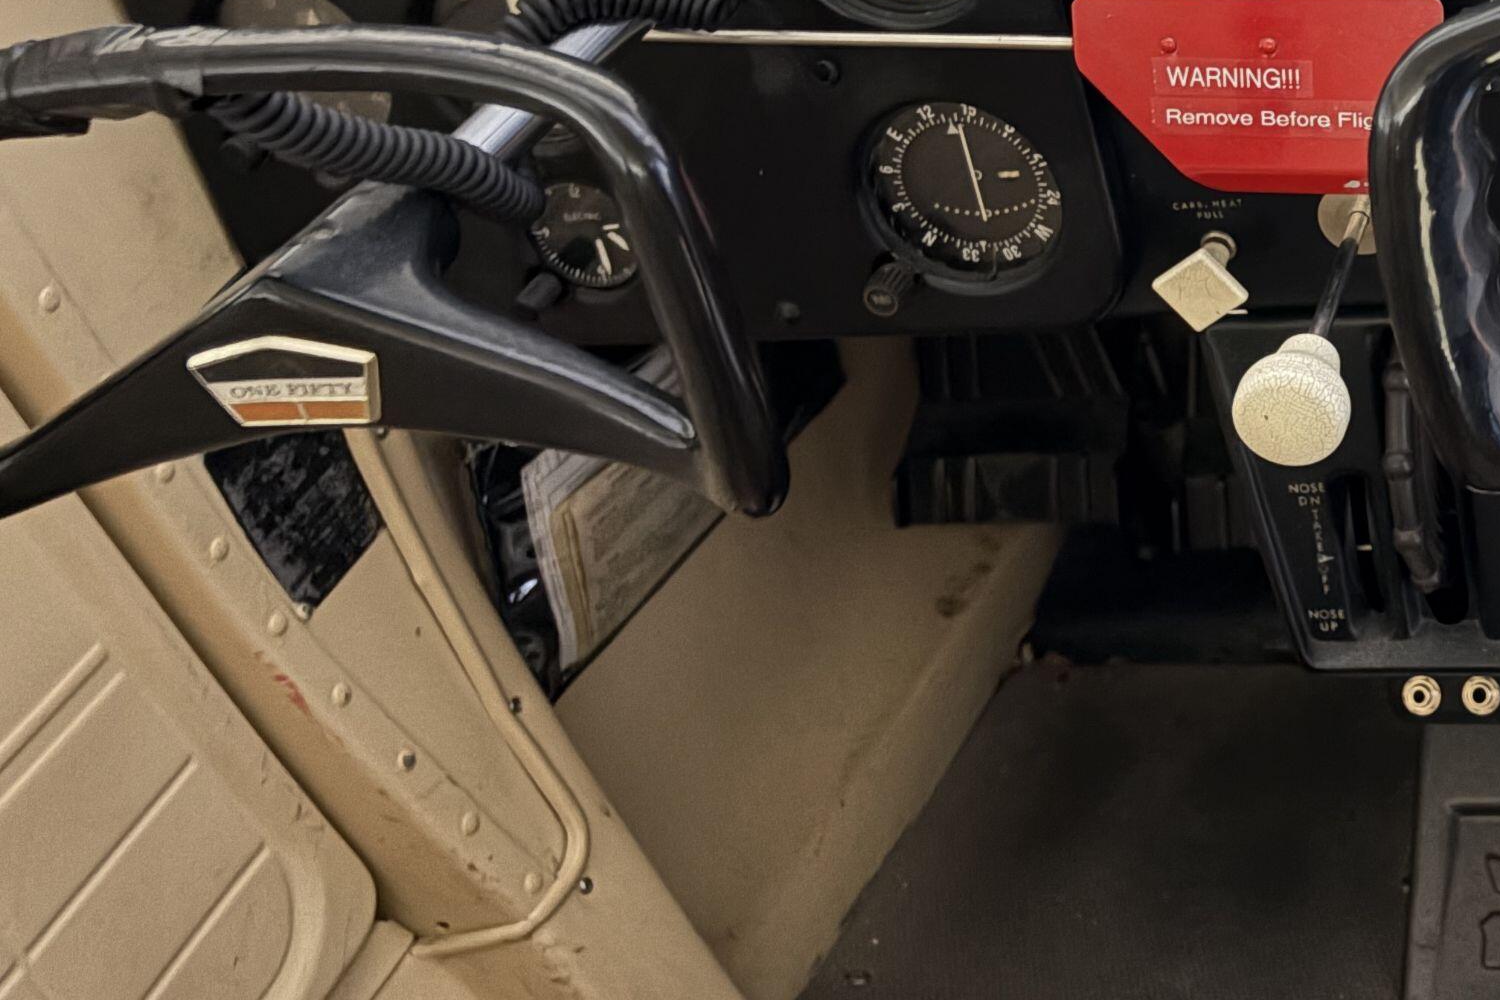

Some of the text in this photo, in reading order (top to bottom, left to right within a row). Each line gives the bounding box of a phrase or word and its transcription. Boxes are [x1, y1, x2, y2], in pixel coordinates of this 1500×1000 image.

[1166, 65, 1301, 90] WARNING!!!
[1165, 108, 1331, 128] Remove Before
[229, 381, 352, 400] ONE FIFTY
[1288, 482, 1325, 494] NOSE
[1298, 495, 1321, 507] DN
[1308, 608, 1345, 621] NOSE
[1319, 621, 1339, 632] UP
